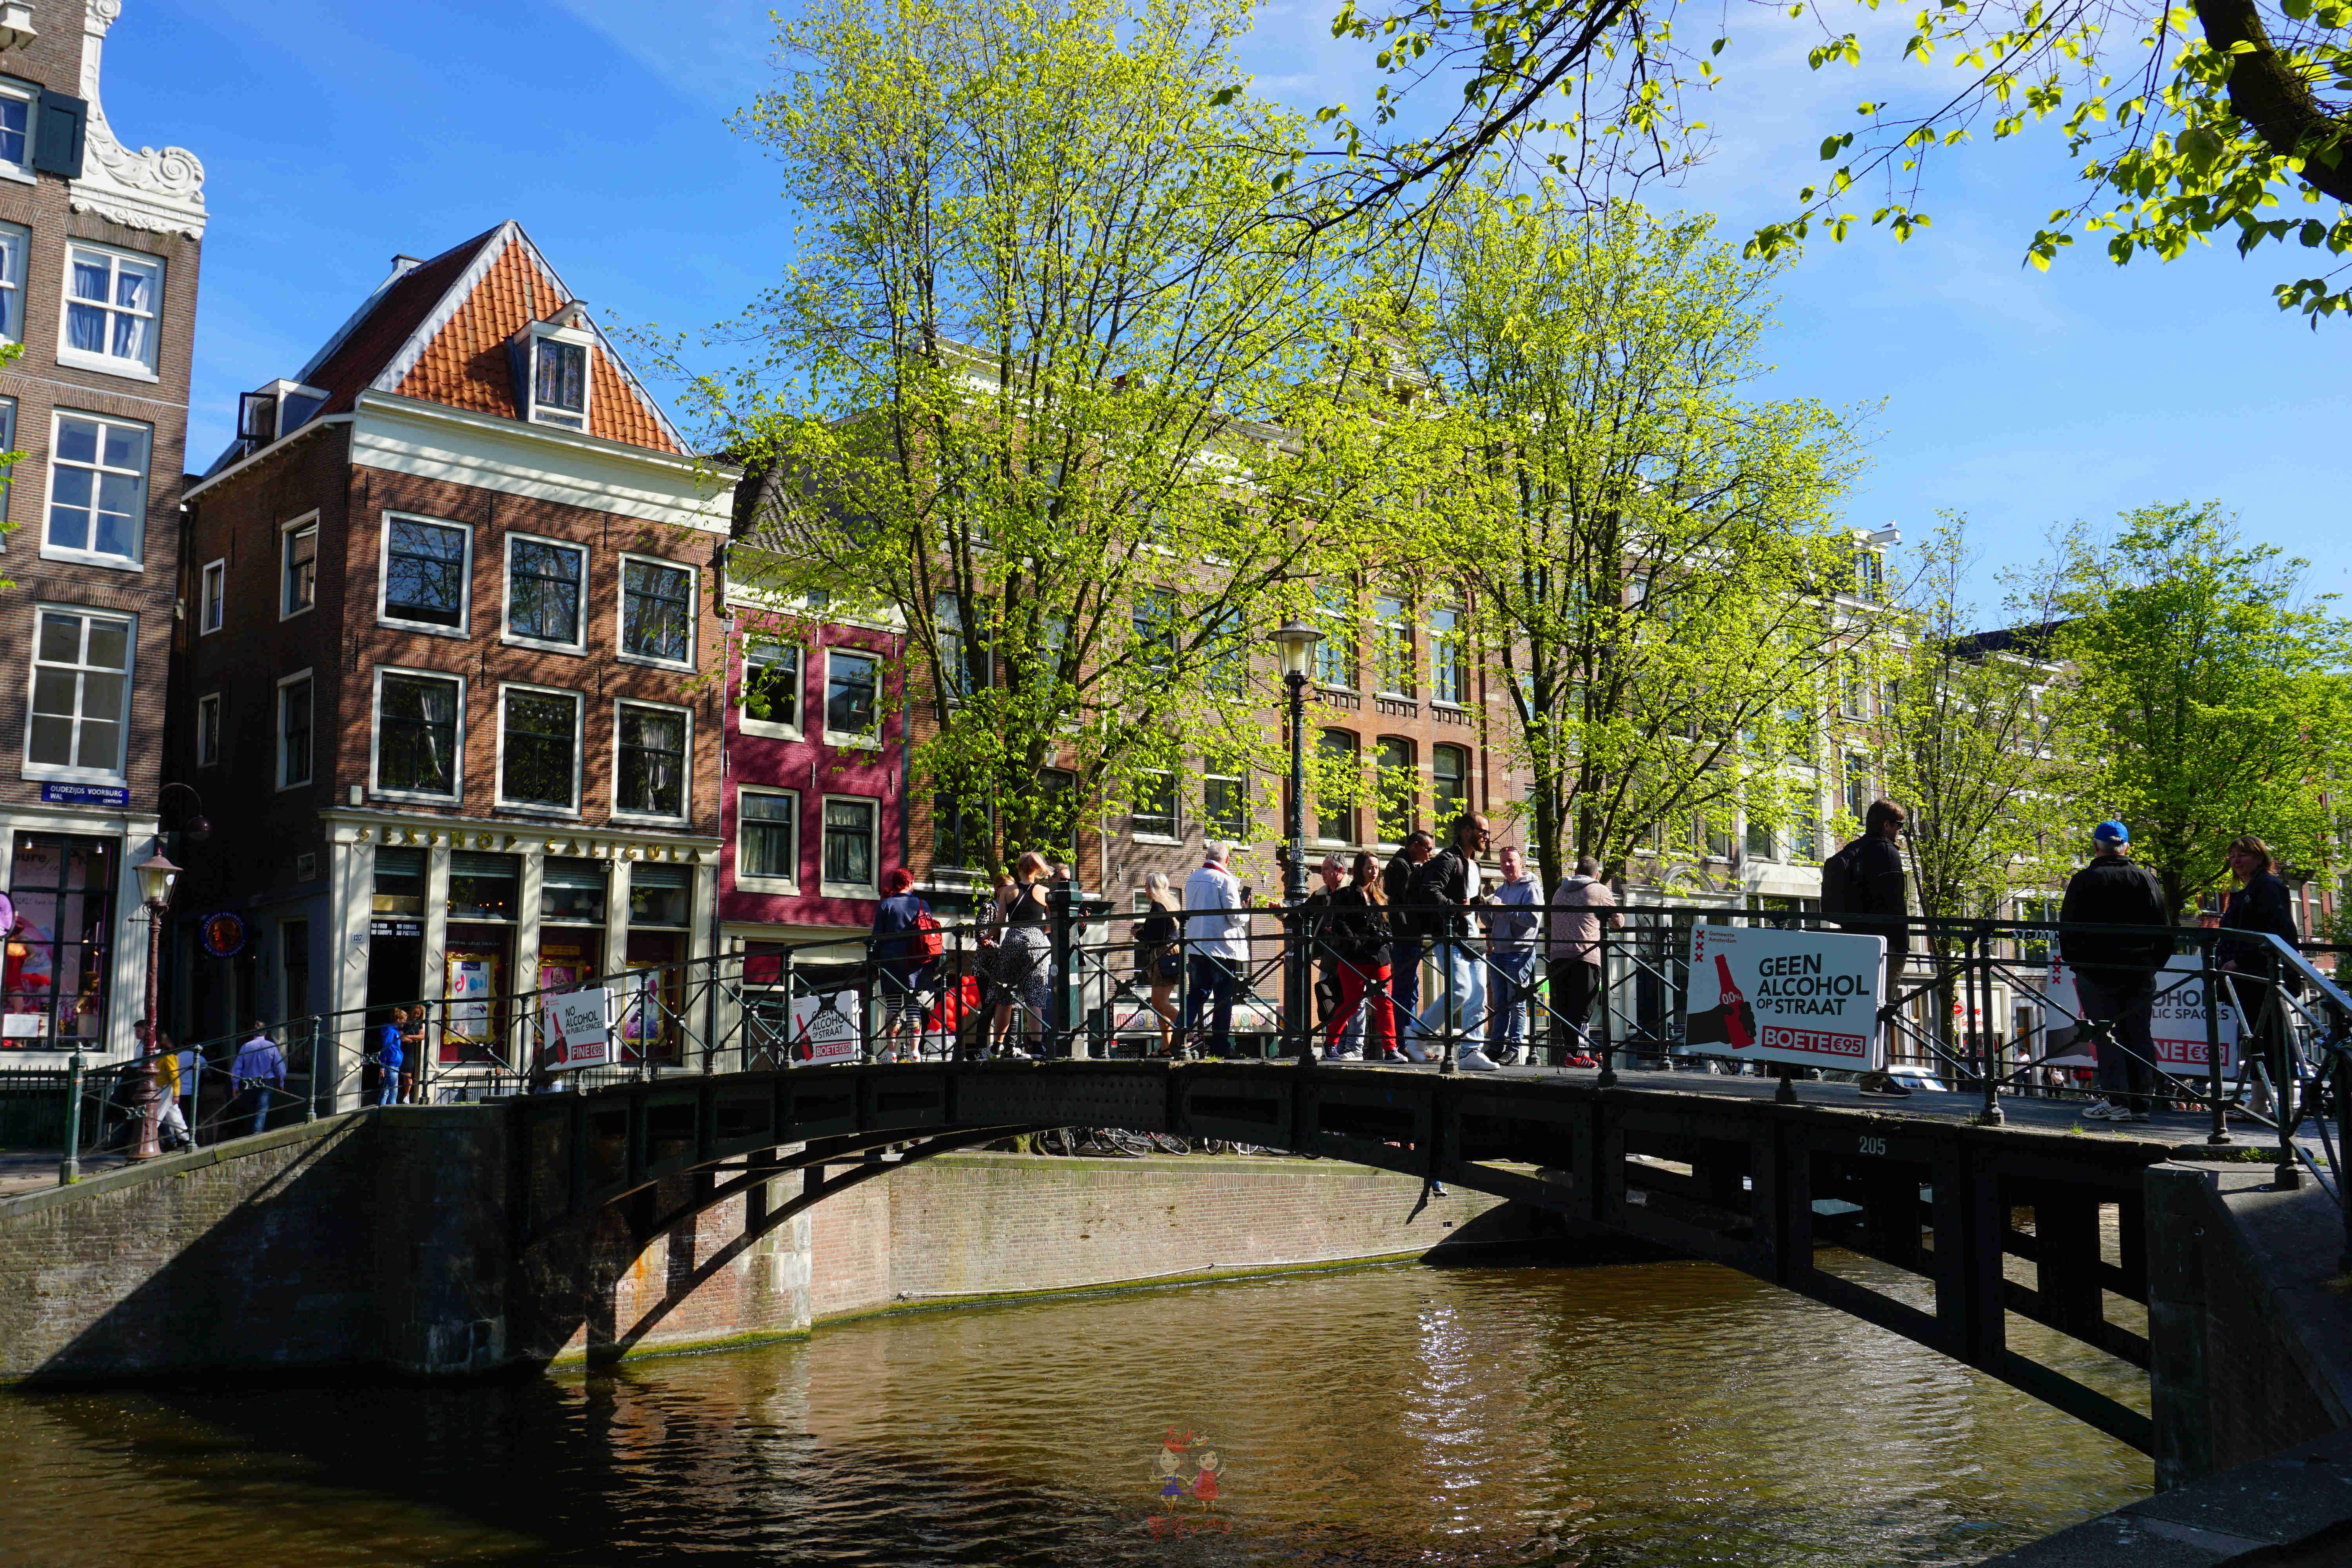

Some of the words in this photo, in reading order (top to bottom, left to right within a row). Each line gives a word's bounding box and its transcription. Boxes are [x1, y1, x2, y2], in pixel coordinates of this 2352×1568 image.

[51, 786, 85, 795] OUDEZIJDS
[88, 788, 123, 797] VOORBURG
[359, 826, 517, 851] SEXSHOP
[544, 838, 702, 863] CALIGULA
[1759, 953, 1822, 977] GEEN
[1757, 975, 1869, 996] ALCOHOL
[566, 1006, 575, 1017] NO
[1757, 998, 1772, 1009] OP
[1775, 998, 1847, 1015] STRAAT
[566, 1010, 598, 1028] ALCOHOL
[571, 1025, 585, 1034] PUBLIC
[586, 1020, 603, 1031] SPACES
[819, 1025, 843, 1038] STRAAT
[1764, 1028, 1829, 1051] BOETE
[1833, 1038, 1861, 1053] €95
[573, 1045, 591, 1059] FINE
[592, 1045, 602, 1055] €95
[817, 1044, 839, 1056] BOETE
[1859, 1136, 1886, 1154] 205
